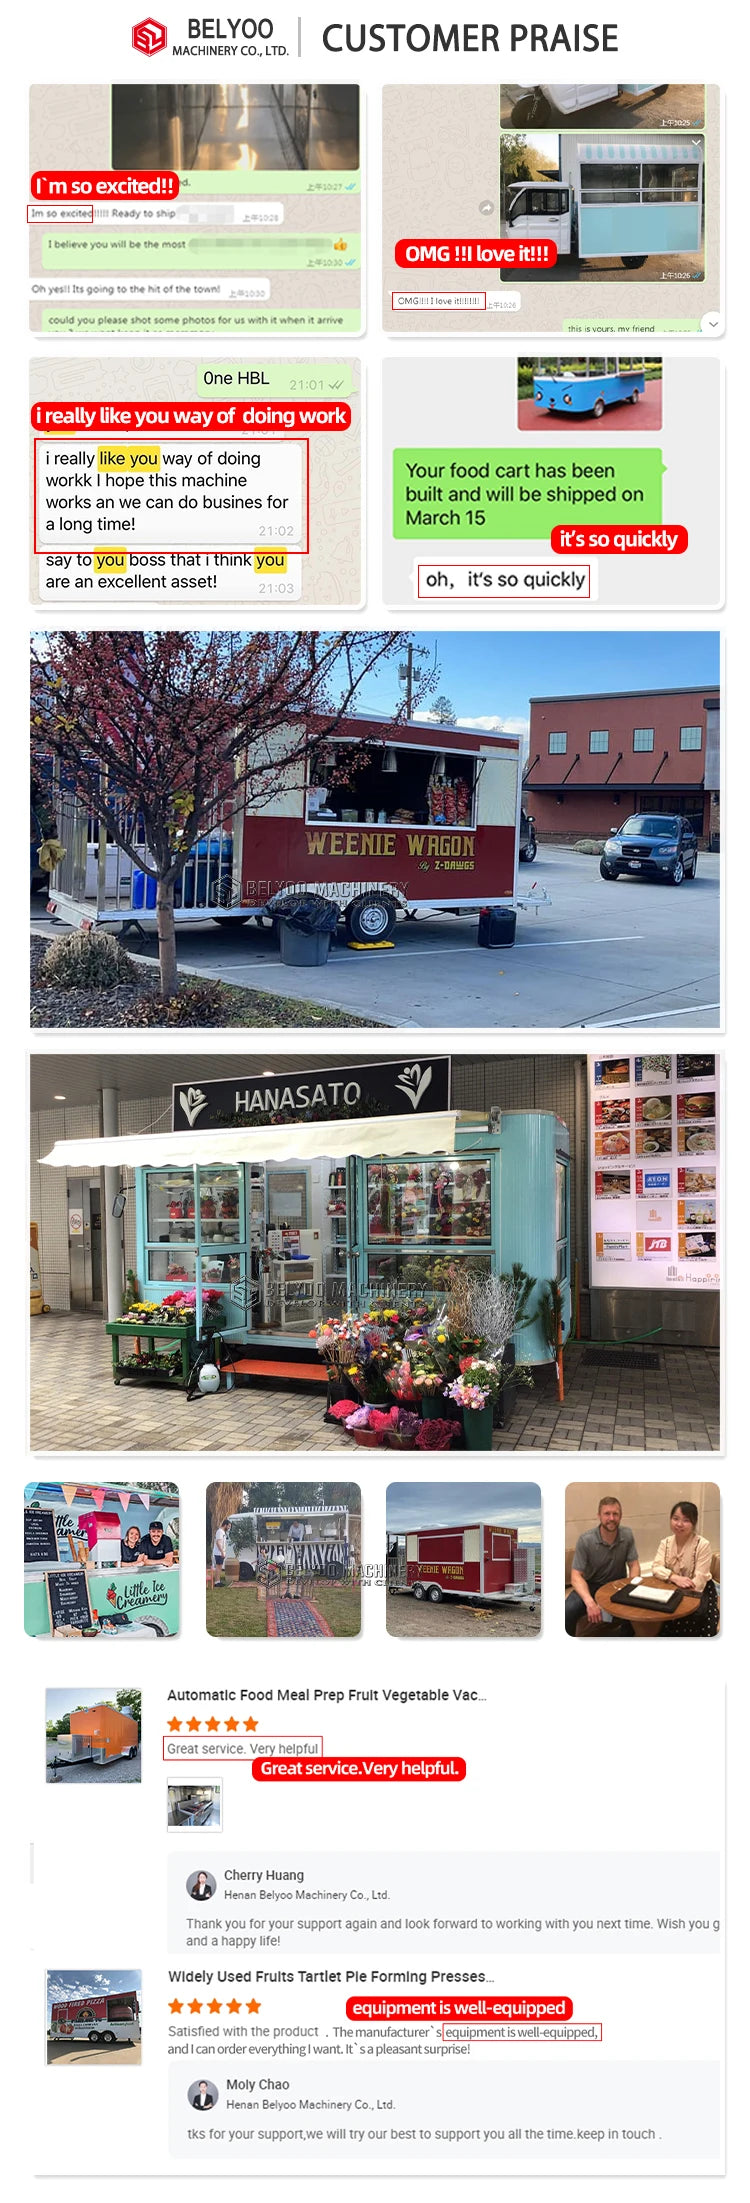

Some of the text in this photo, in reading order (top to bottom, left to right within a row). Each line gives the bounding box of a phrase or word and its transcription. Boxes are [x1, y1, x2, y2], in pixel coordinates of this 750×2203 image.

[188, 18, 273, 39] BELYOO
[323, 24, 618, 52] CUSTOMER PRAISE
[172, 46, 289, 57] MACHINERY CO., LTD.
[32, 209, 43, 217] Im
[112, 209, 141, 219] Ready
[144, 210, 153, 218] to
[156, 210, 176, 219] ship
[54, 240, 88, 248] believe
[90, 242, 108, 250] you
[110, 240, 126, 248] will
[129, 240, 141, 248] be
[144, 240, 159, 248] the
[238, 371, 270, 384] HBL
[290, 379, 324, 391] 21:01
[46, 451, 260, 468] i really like you way of doing
[406, 463, 614, 478] Your food cart has been
[46, 473, 92, 487] workk
[105, 473, 145, 490] hope
[149, 473, 177, 487] this
[181, 473, 247, 487] machine
[46, 495, 289, 509] works an we can do busines for
[406, 486, 643, 505] built and will be shipped on
[406, 510, 485, 525] March 15
[46, 517, 135, 534] a long time!
[259, 526, 294, 537] 21:02
[426, 571, 454, 589] oh,
[498, 575, 518, 587] so
[524, 571, 585, 591] quickly
[305, 831, 475, 857] WEENIE WAGON
[418, 861, 475, 872] By Z-DAWGS
[235, 1082, 362, 1113] HANASATO
[648, 1239, 668, 1249] JTB
[442, 1566, 464, 1575] WAGON
[124, 1580, 165, 1598] Little Ice
[116, 1593, 168, 1610] Creamery
[167, 1689, 236, 1701] Automatic
[240, 1689, 273, 1701] Food
[278, 1689, 309, 1701] Meal
[314, 1689, 344, 1703] Prep
[349, 1689, 378, 1701] Fruit
[382, 1689, 449, 1704] Vegetable
[167, 1743, 318, 1757] Great service. Very helpful
[224, 1869, 304, 1883] Cherry Huang
[225, 1890, 390, 1902] Henan Belyoo Machinery Co., Ltd.
[168, 1970, 214, 1985] Widely
[218, 1971, 251, 1982] Used
[256, 1971, 294, 1982] Fruits
[298, 1970, 341, 1982] Tartlet
[346, 1971, 367, 1982] Pie
[371, 1971, 427, 1985] Forming
[168, 2026, 219, 2037] Satisfied
[223, 2026, 247, 2037] with
[251, 2026, 270, 2037] the
[274, 2026, 318, 2040] product
[333, 2027, 353, 2037] The
[446, 2026, 598, 2040] equipment is well-equipped,
[227, 2078, 290, 2093] Moly Chao
